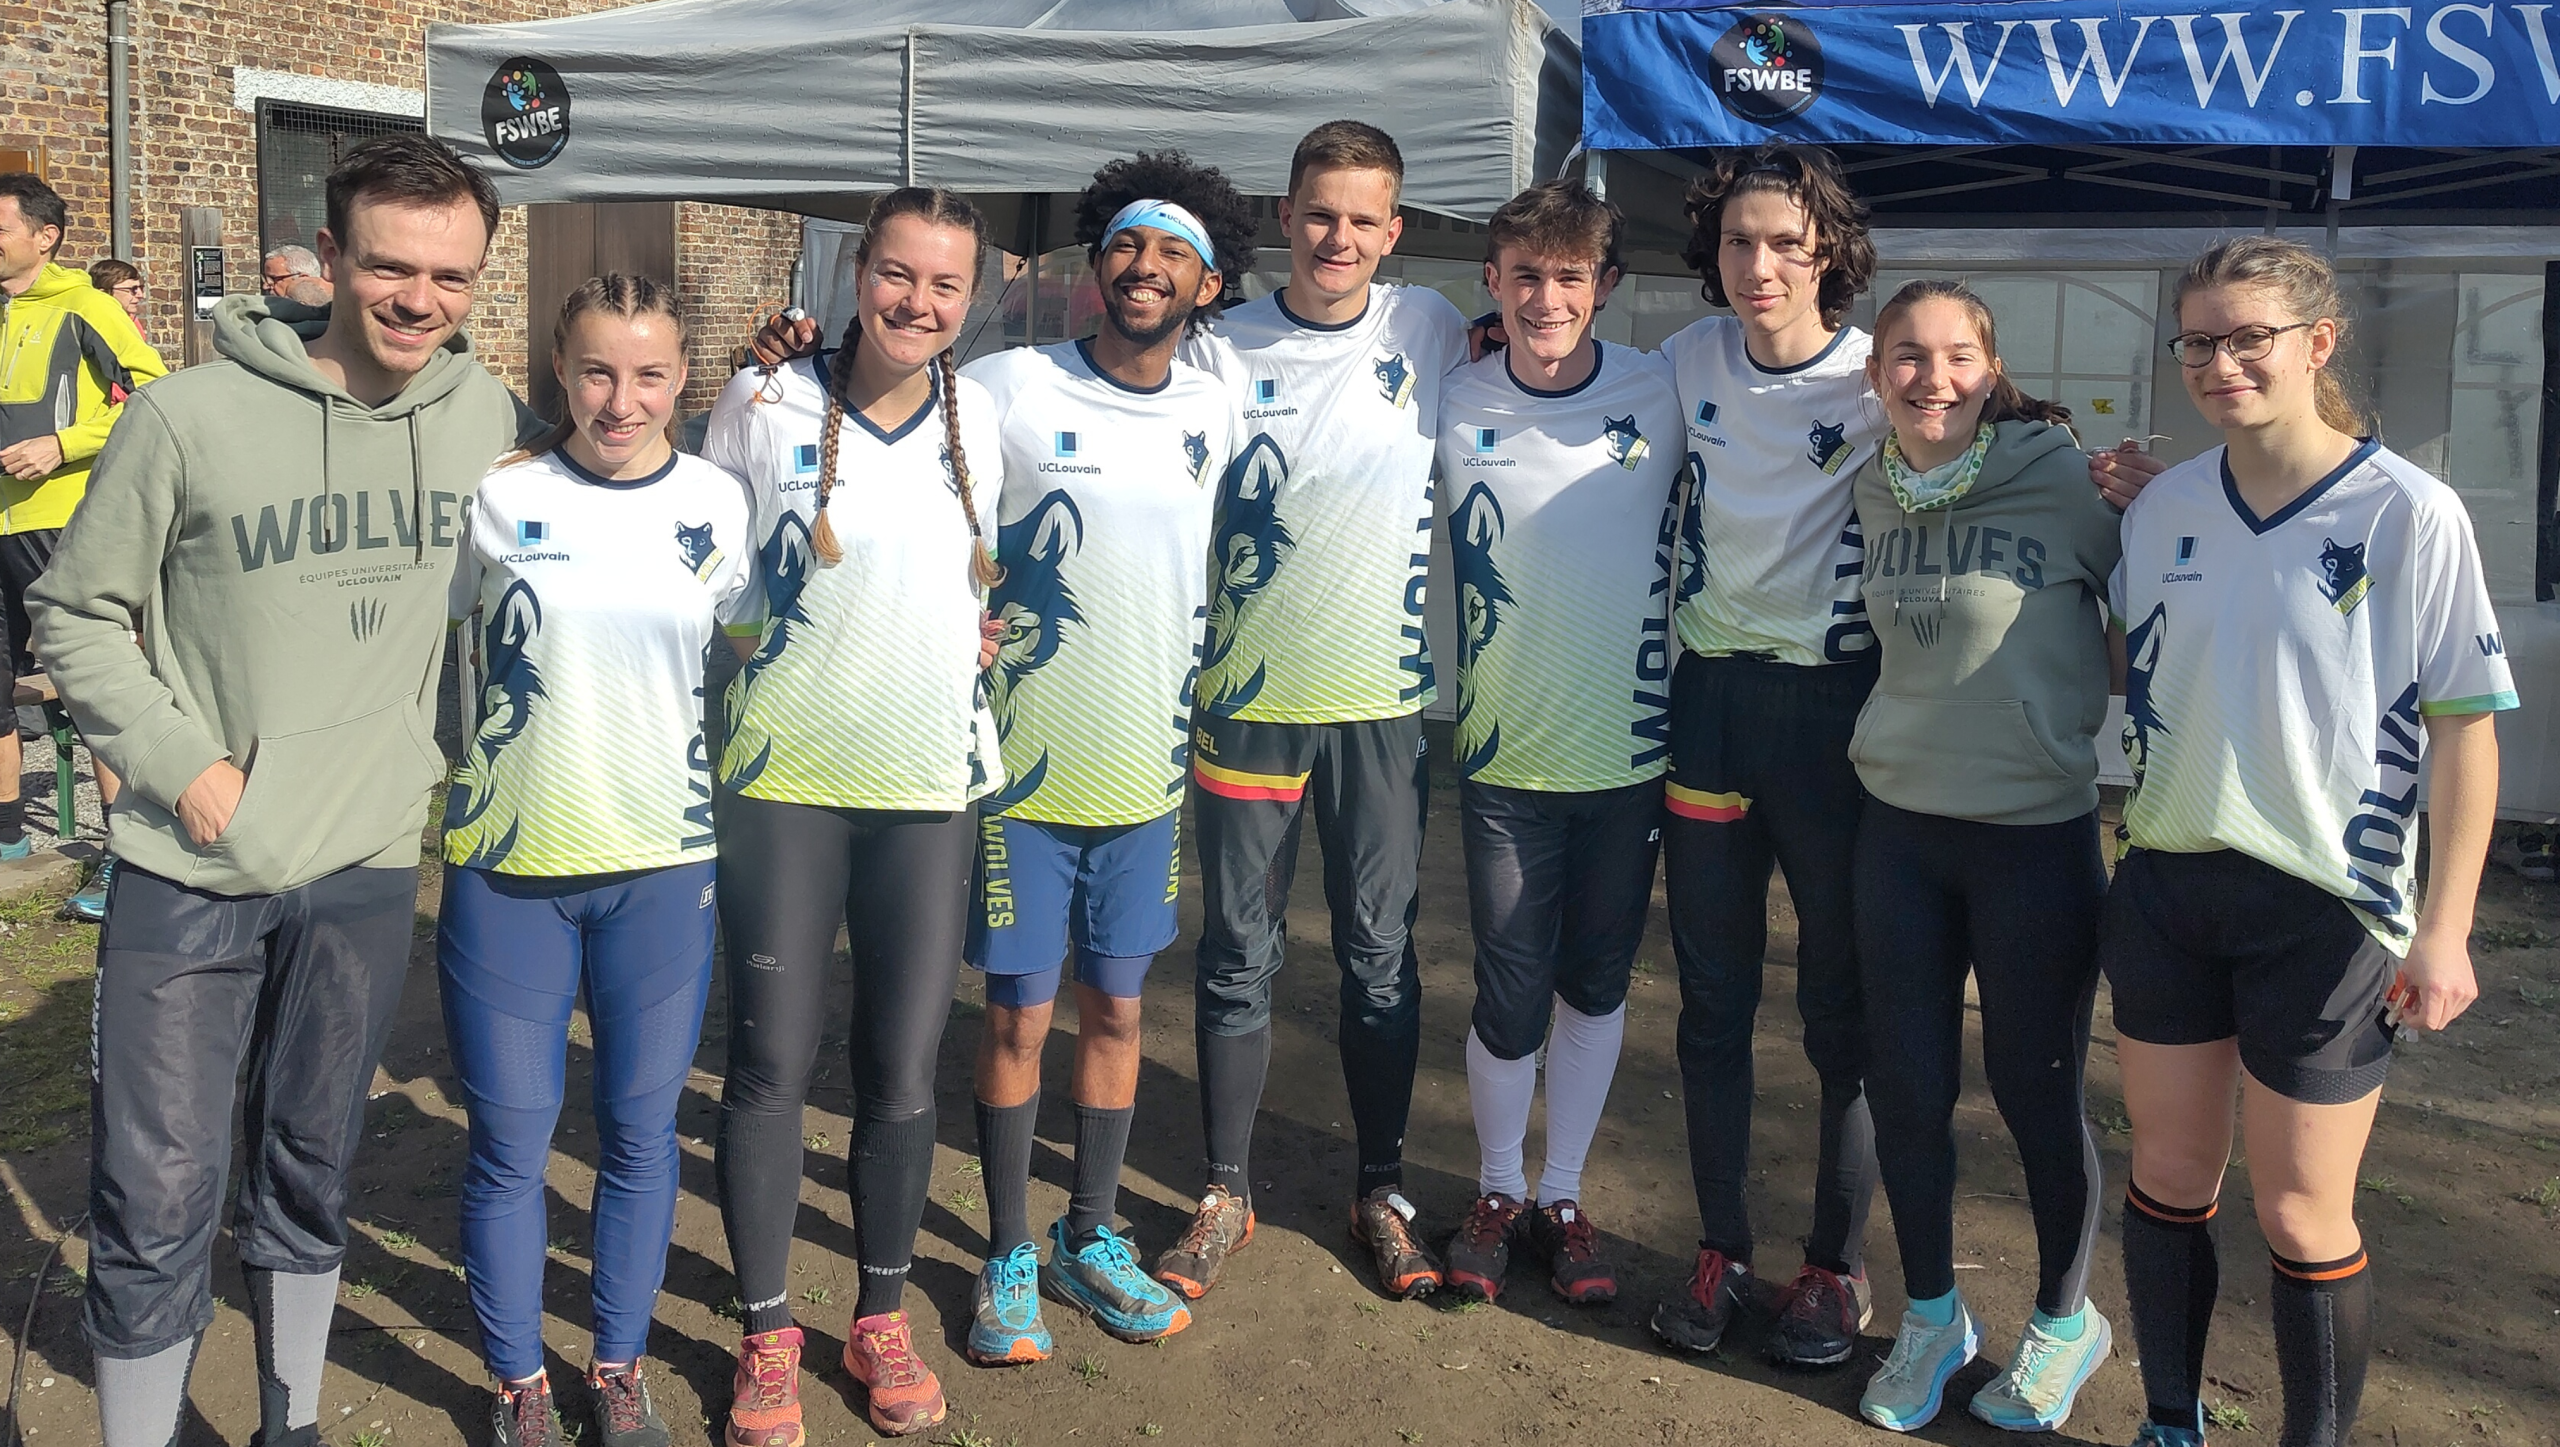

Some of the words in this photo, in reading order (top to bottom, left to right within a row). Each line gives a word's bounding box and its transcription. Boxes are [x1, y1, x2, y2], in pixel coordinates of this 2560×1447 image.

[1723, 67, 1812, 93] FSWBE
[495, 106, 562, 145] FSWBE
[1242, 406, 1298, 420] UCLouvain
[1038, 462, 1101, 475] UCLouvain
[1462, 457, 1516, 467] UCLouvain
[778, 479, 845, 493] UCLouin
[499, 551, 570, 564] UCLouvain
[299, 568, 348, 584] ÉQUIPES
[351, 562, 436, 576] UNIVERSITAIRES
[337, 574, 402, 587] UCLOUVAIN
[2162, 570, 2203, 583] UCLouvain
[1195, 726, 1219, 756] BEL
[981, 815, 1015, 928] WOLVES
